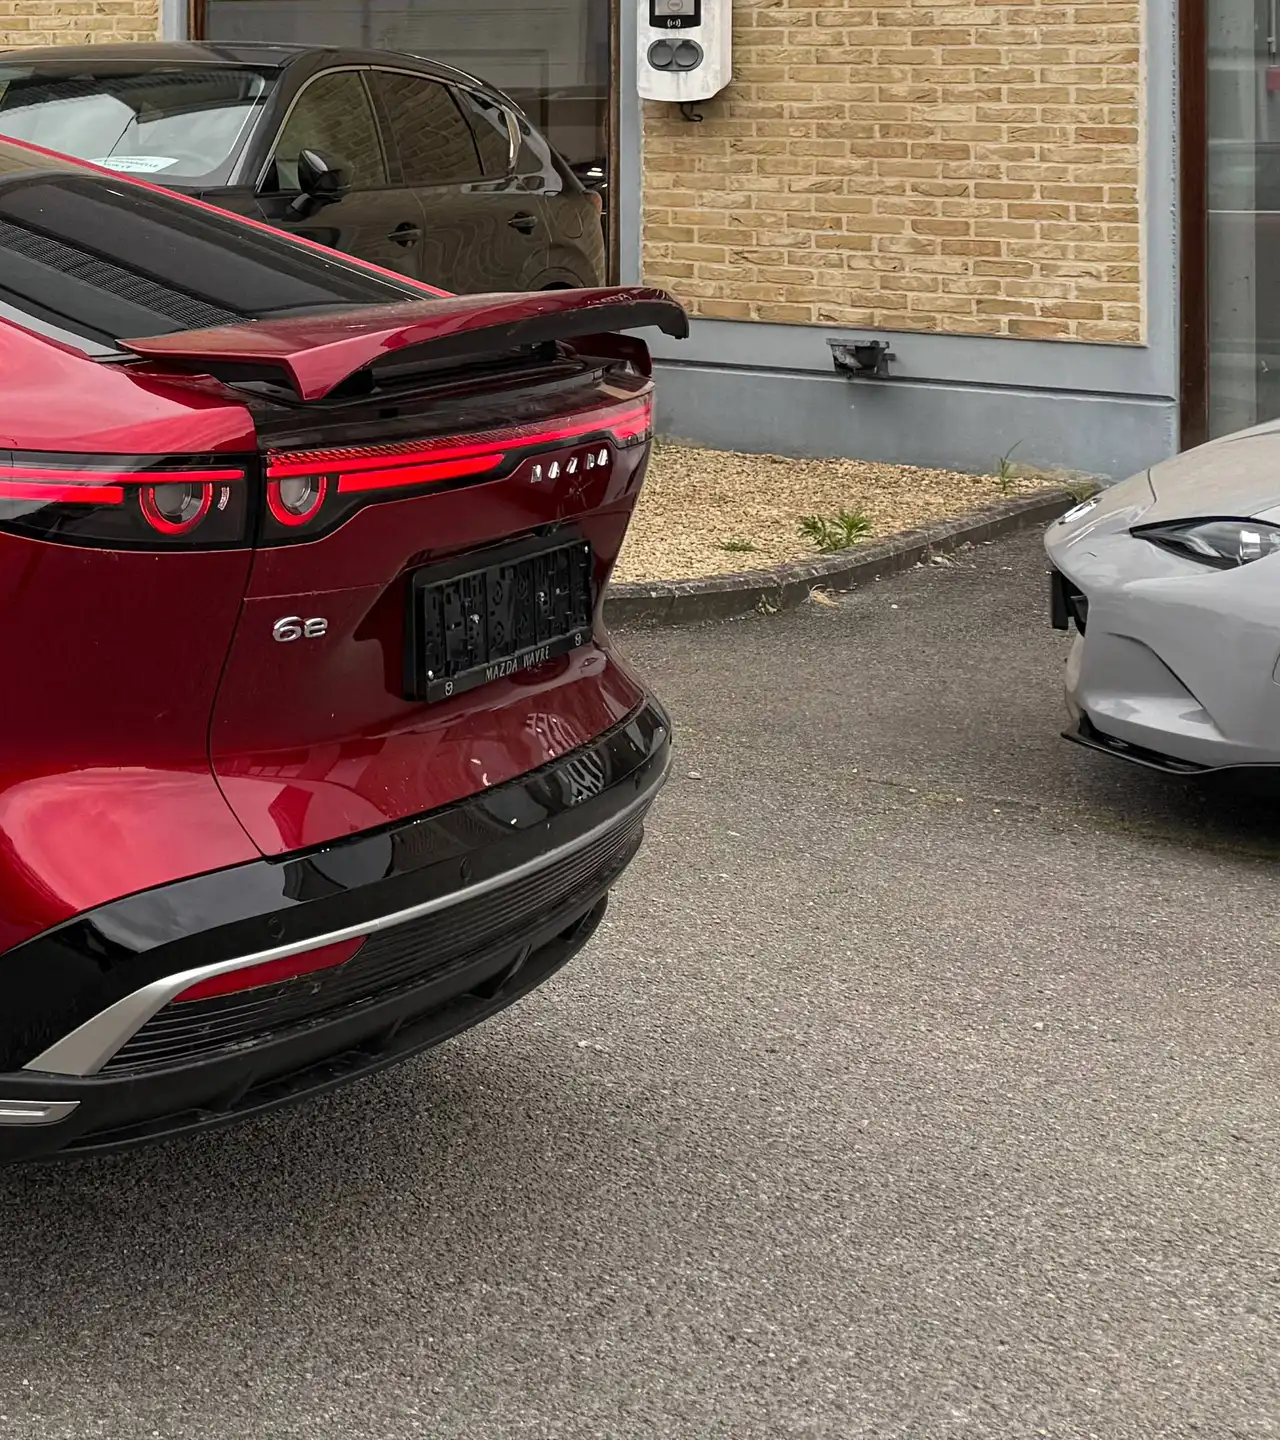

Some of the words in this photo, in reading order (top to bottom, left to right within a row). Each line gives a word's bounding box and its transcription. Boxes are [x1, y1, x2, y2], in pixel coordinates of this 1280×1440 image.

[272, 615, 328, 643] 6e
[486, 659, 518, 682] MAZDA
[523, 645, 549, 669] WAVRE
